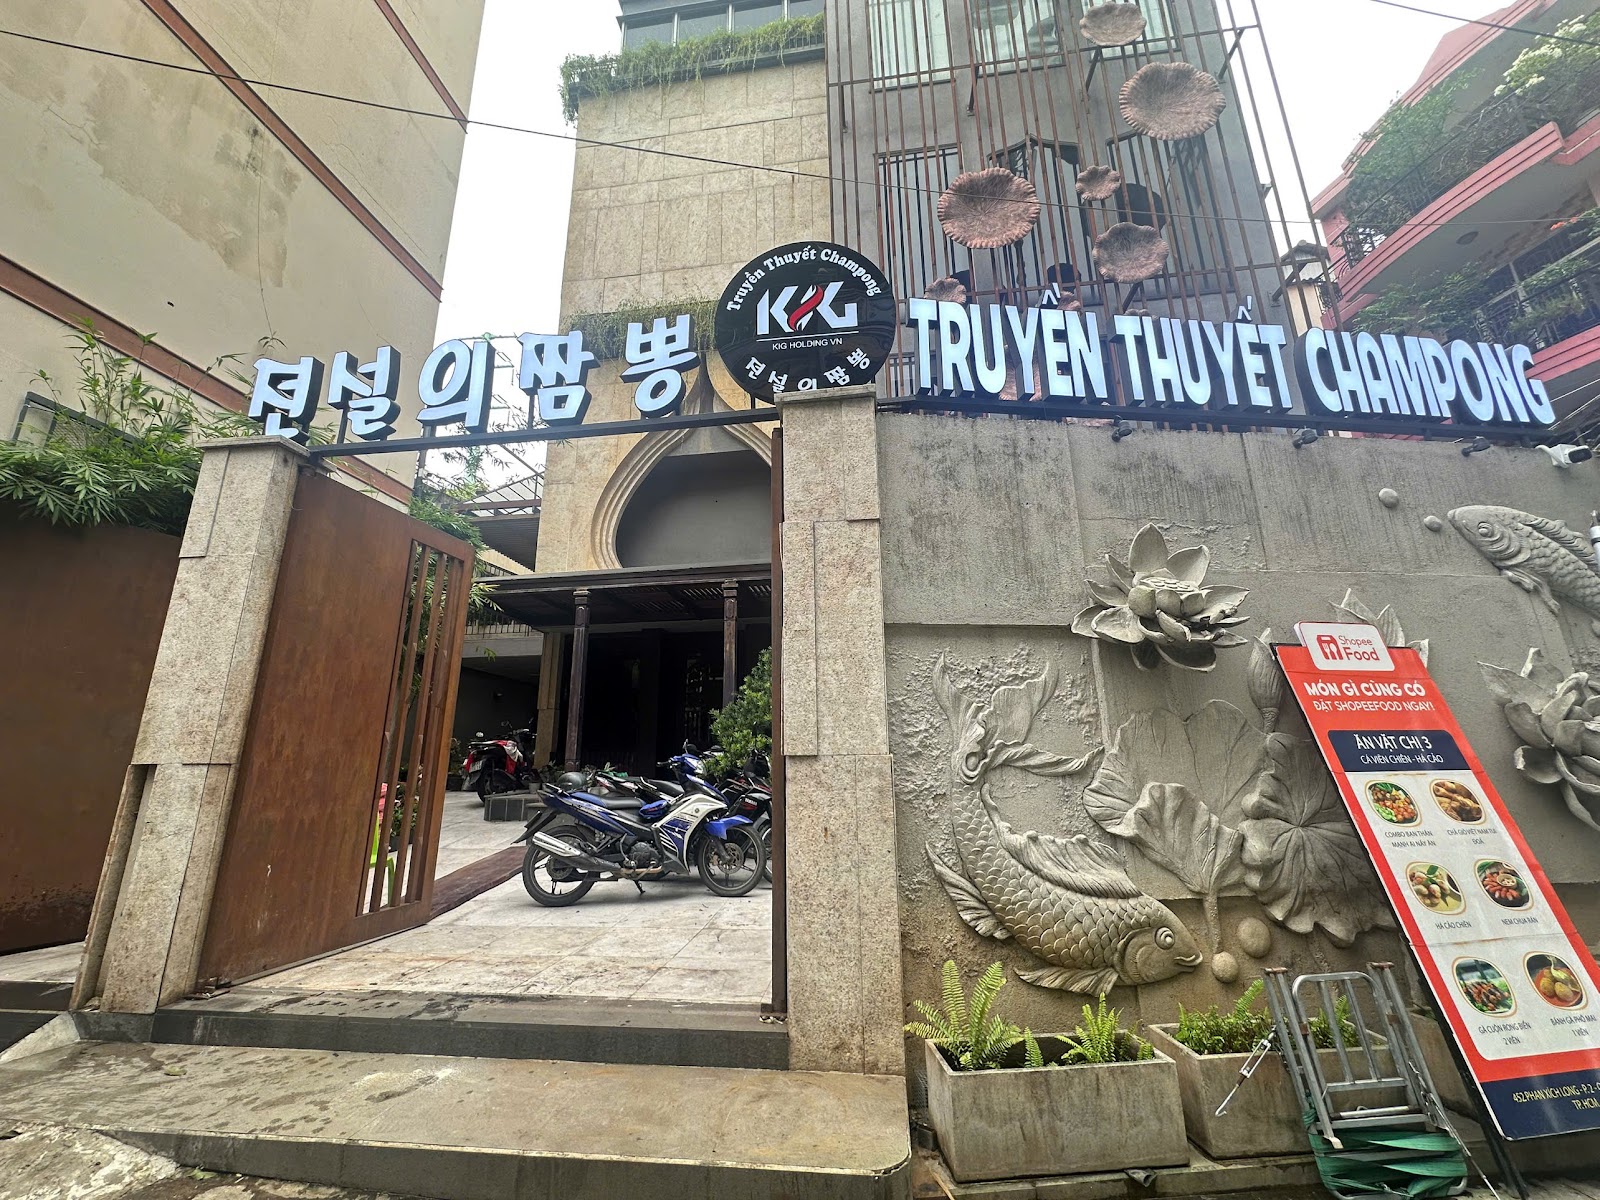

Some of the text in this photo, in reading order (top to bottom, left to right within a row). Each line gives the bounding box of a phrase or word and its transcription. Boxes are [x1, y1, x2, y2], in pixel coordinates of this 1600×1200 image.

[726, 245, 882, 310] Truyền Thuyết Champong
[789, 340, 828, 349] HOLDING
[830, 338, 842, 346] VN
[908, 288, 1556, 425] TRUYỀN THUYẾT CHAMPONG
[1338, 635, 1373, 648] Shopee
[1343, 647, 1380, 660] Food
[1304, 679, 1341, 696] MÓN
[1342, 680, 1360, 696] GÌ
[1403, 680, 1426, 697] CÓ
[1313, 699, 1435, 712] ĐẶT SHOPEEFOOD NGAY!
[1354, 734, 1432, 752] ĂN VẶT CHỊ 3
[1360, 754, 1372, 764] CÁ
[1372, 754, 1389, 764] VIÊN
[1415, 754, 1427, 763] HÁ
[1559, 1085, 1580, 1097] LONG
